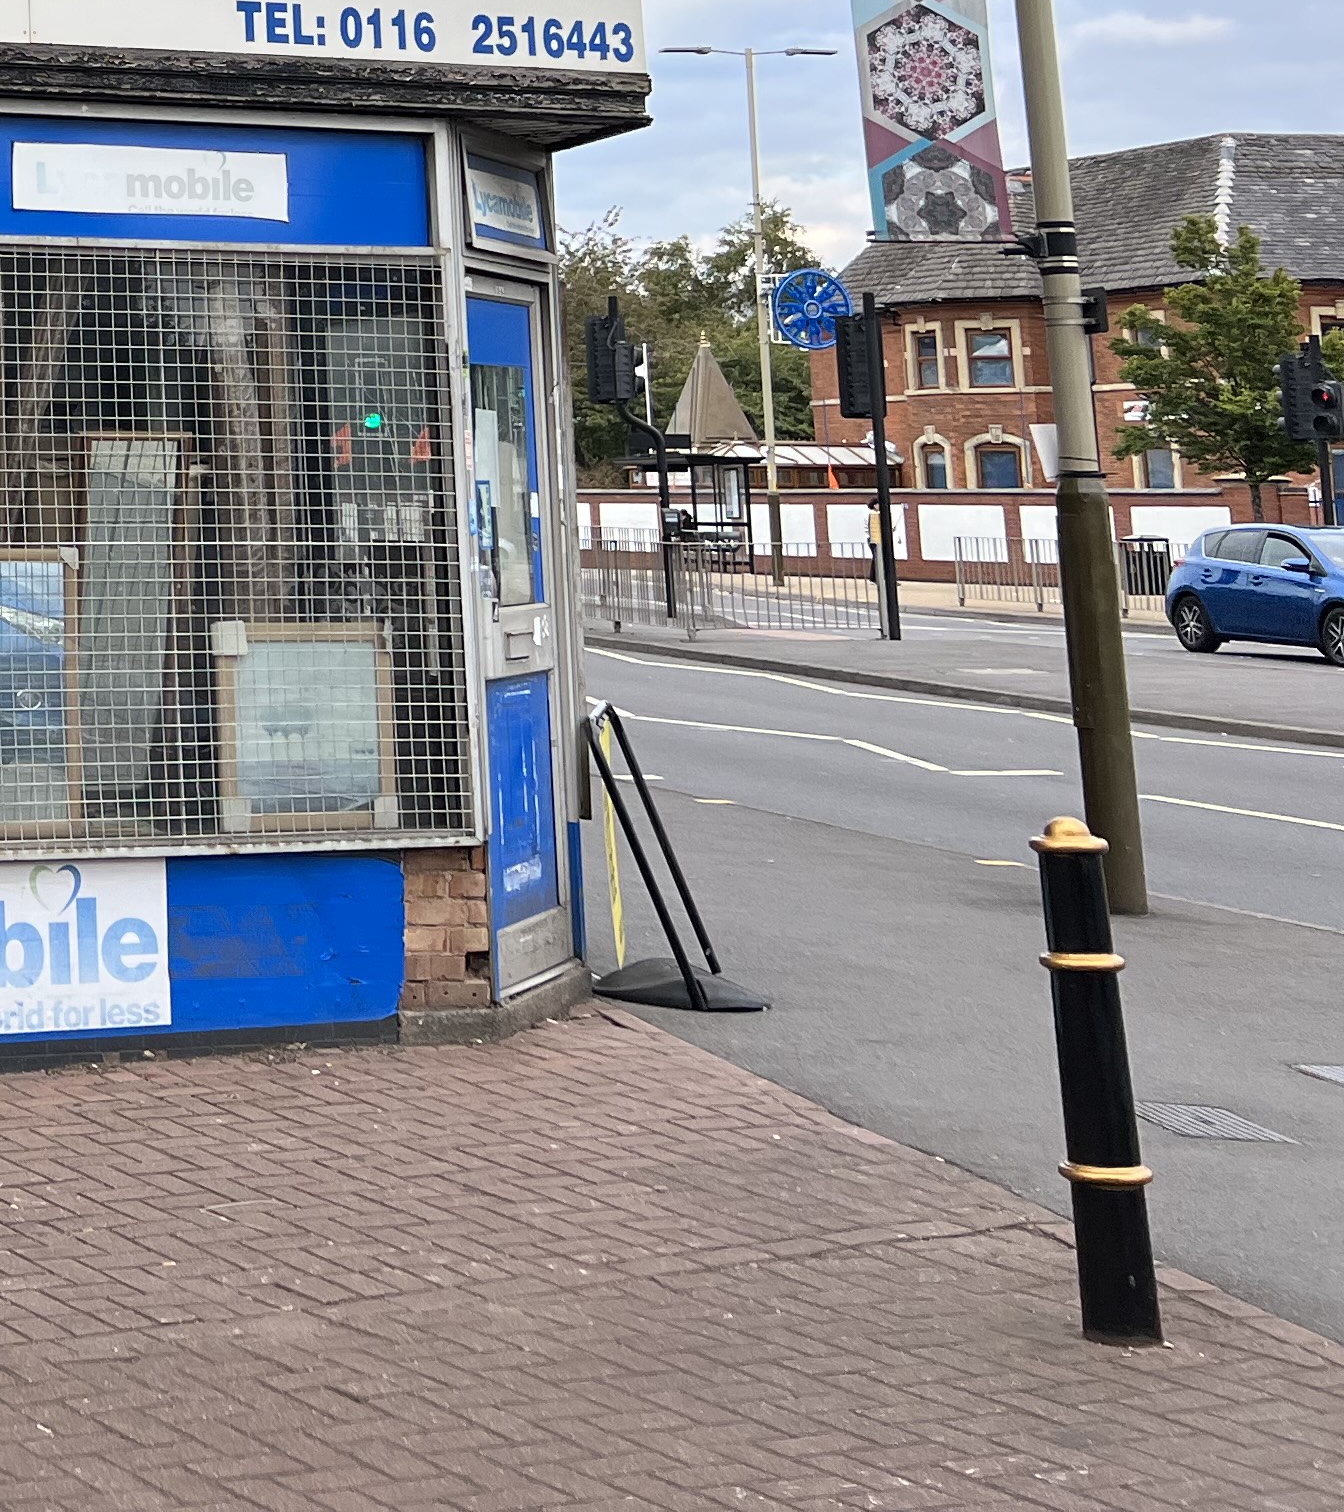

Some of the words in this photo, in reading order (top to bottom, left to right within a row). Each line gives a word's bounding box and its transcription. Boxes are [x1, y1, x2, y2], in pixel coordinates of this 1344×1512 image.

[236, 0, 326, 46] TEL:
[339, 6, 437, 53] 0116
[471, 14, 635, 63] 2516443
[35, 161, 255, 203] Lmobile
[52, 999, 95, 1029] for
[99, 997, 161, 1026] less
